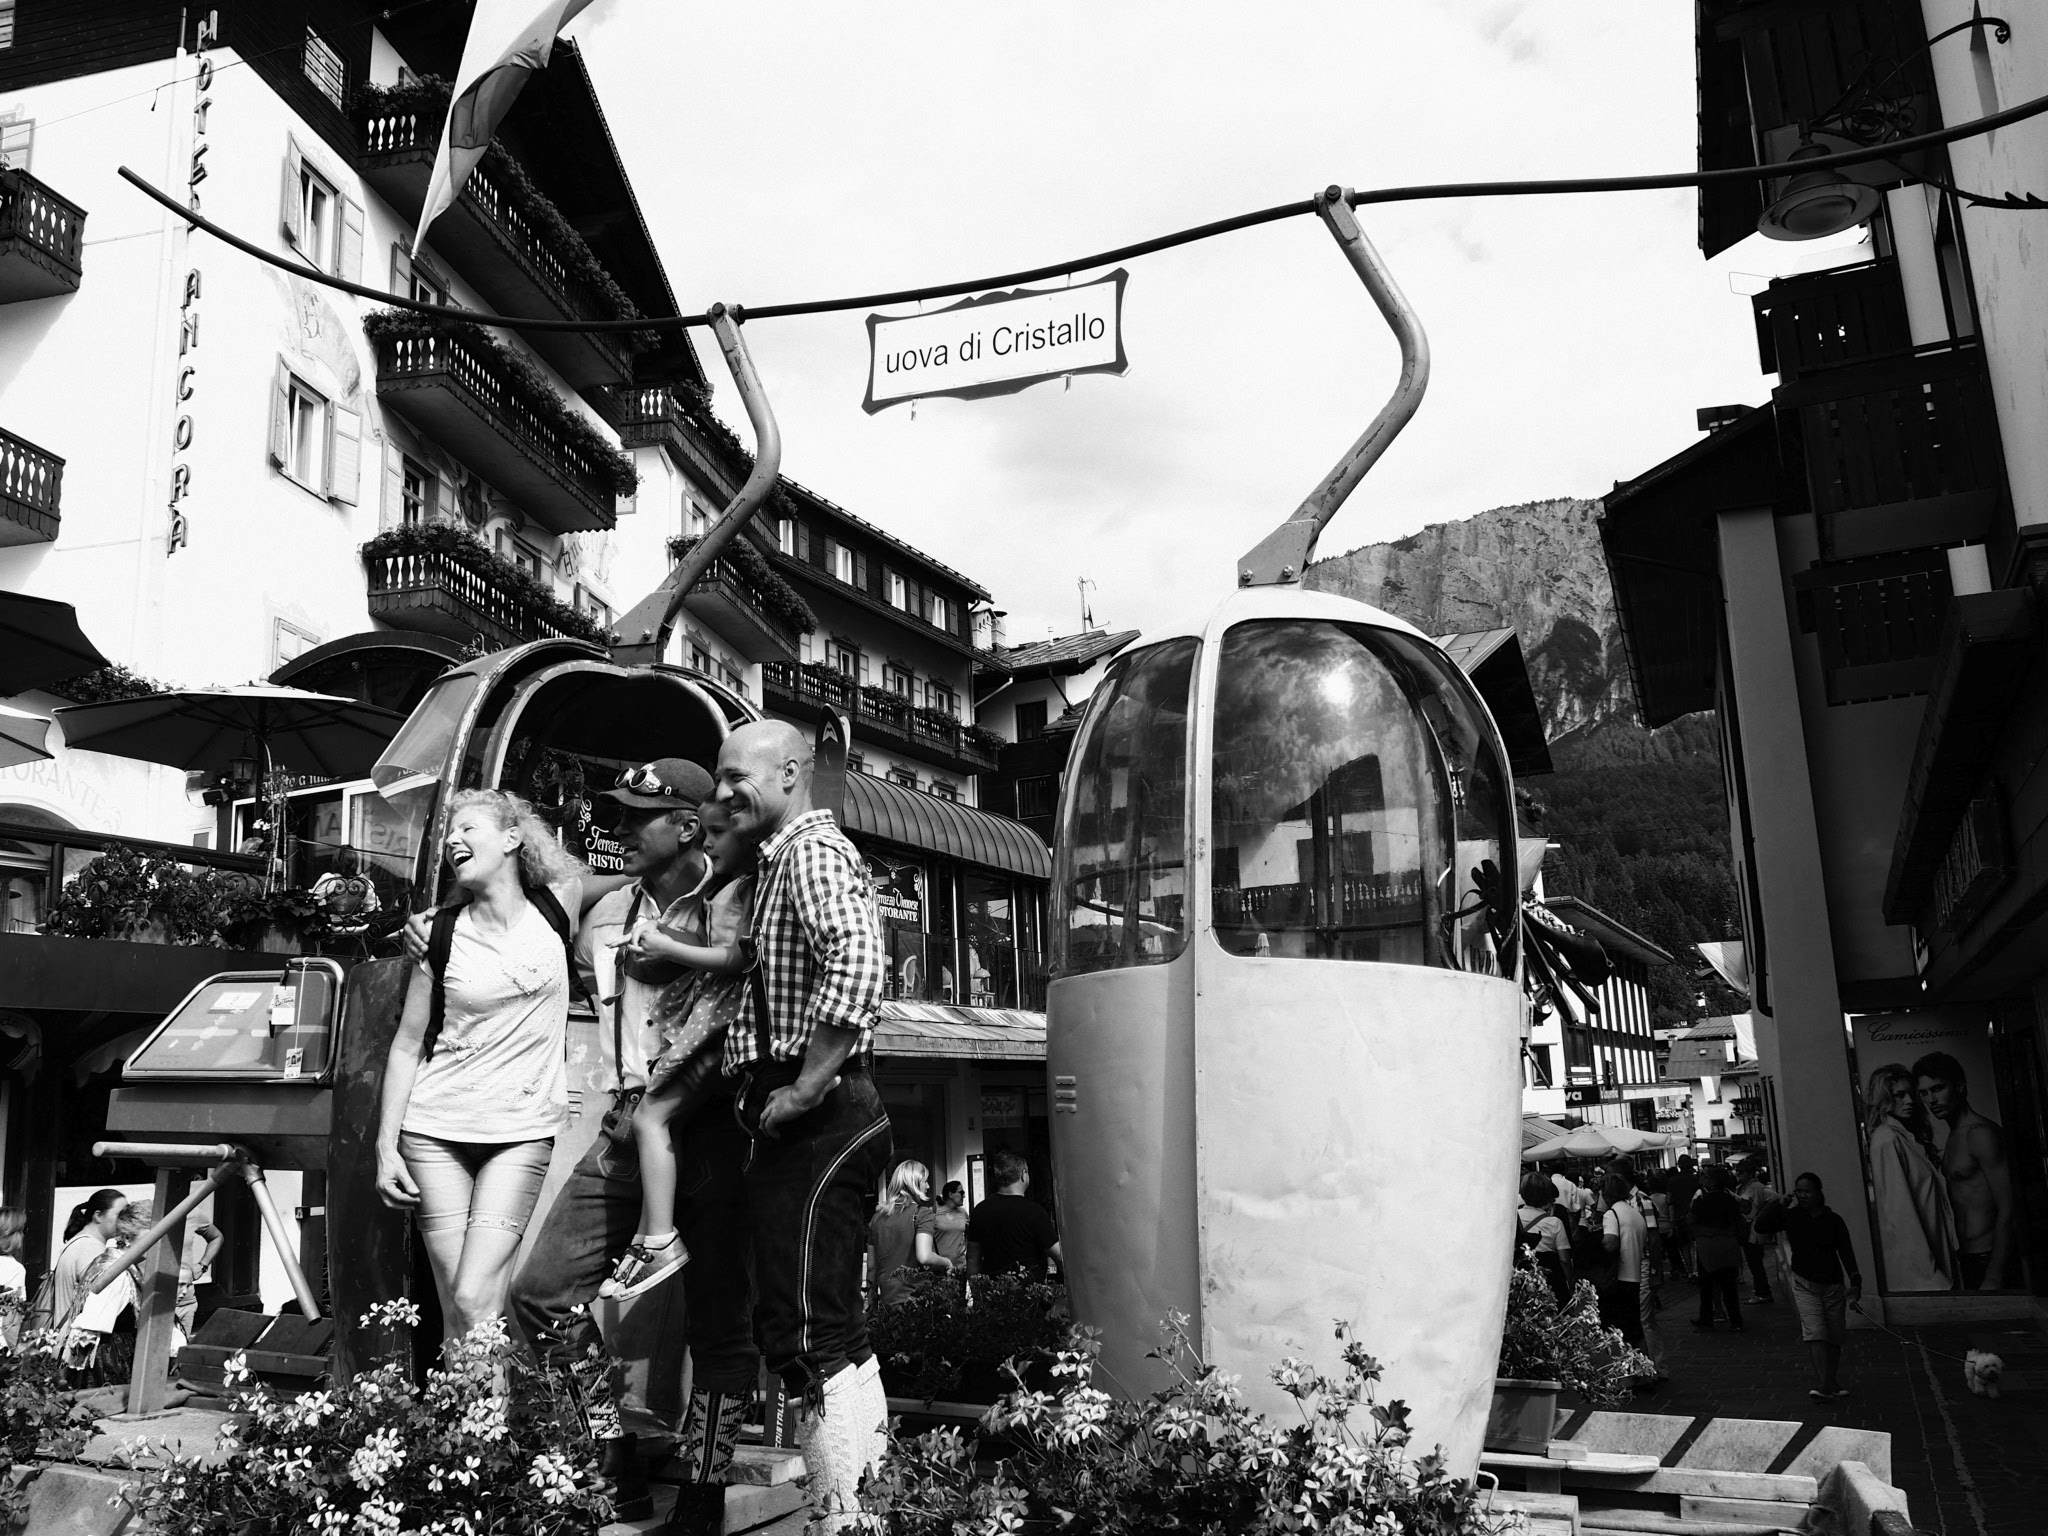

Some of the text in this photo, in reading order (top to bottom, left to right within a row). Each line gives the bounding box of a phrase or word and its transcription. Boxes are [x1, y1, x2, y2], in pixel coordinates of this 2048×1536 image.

[167, 10, 219, 555] HOTEL ANCORA
[886, 312, 1105, 373] uova di Cristallo
[1866, 1021, 1971, 1043] Camicissima
